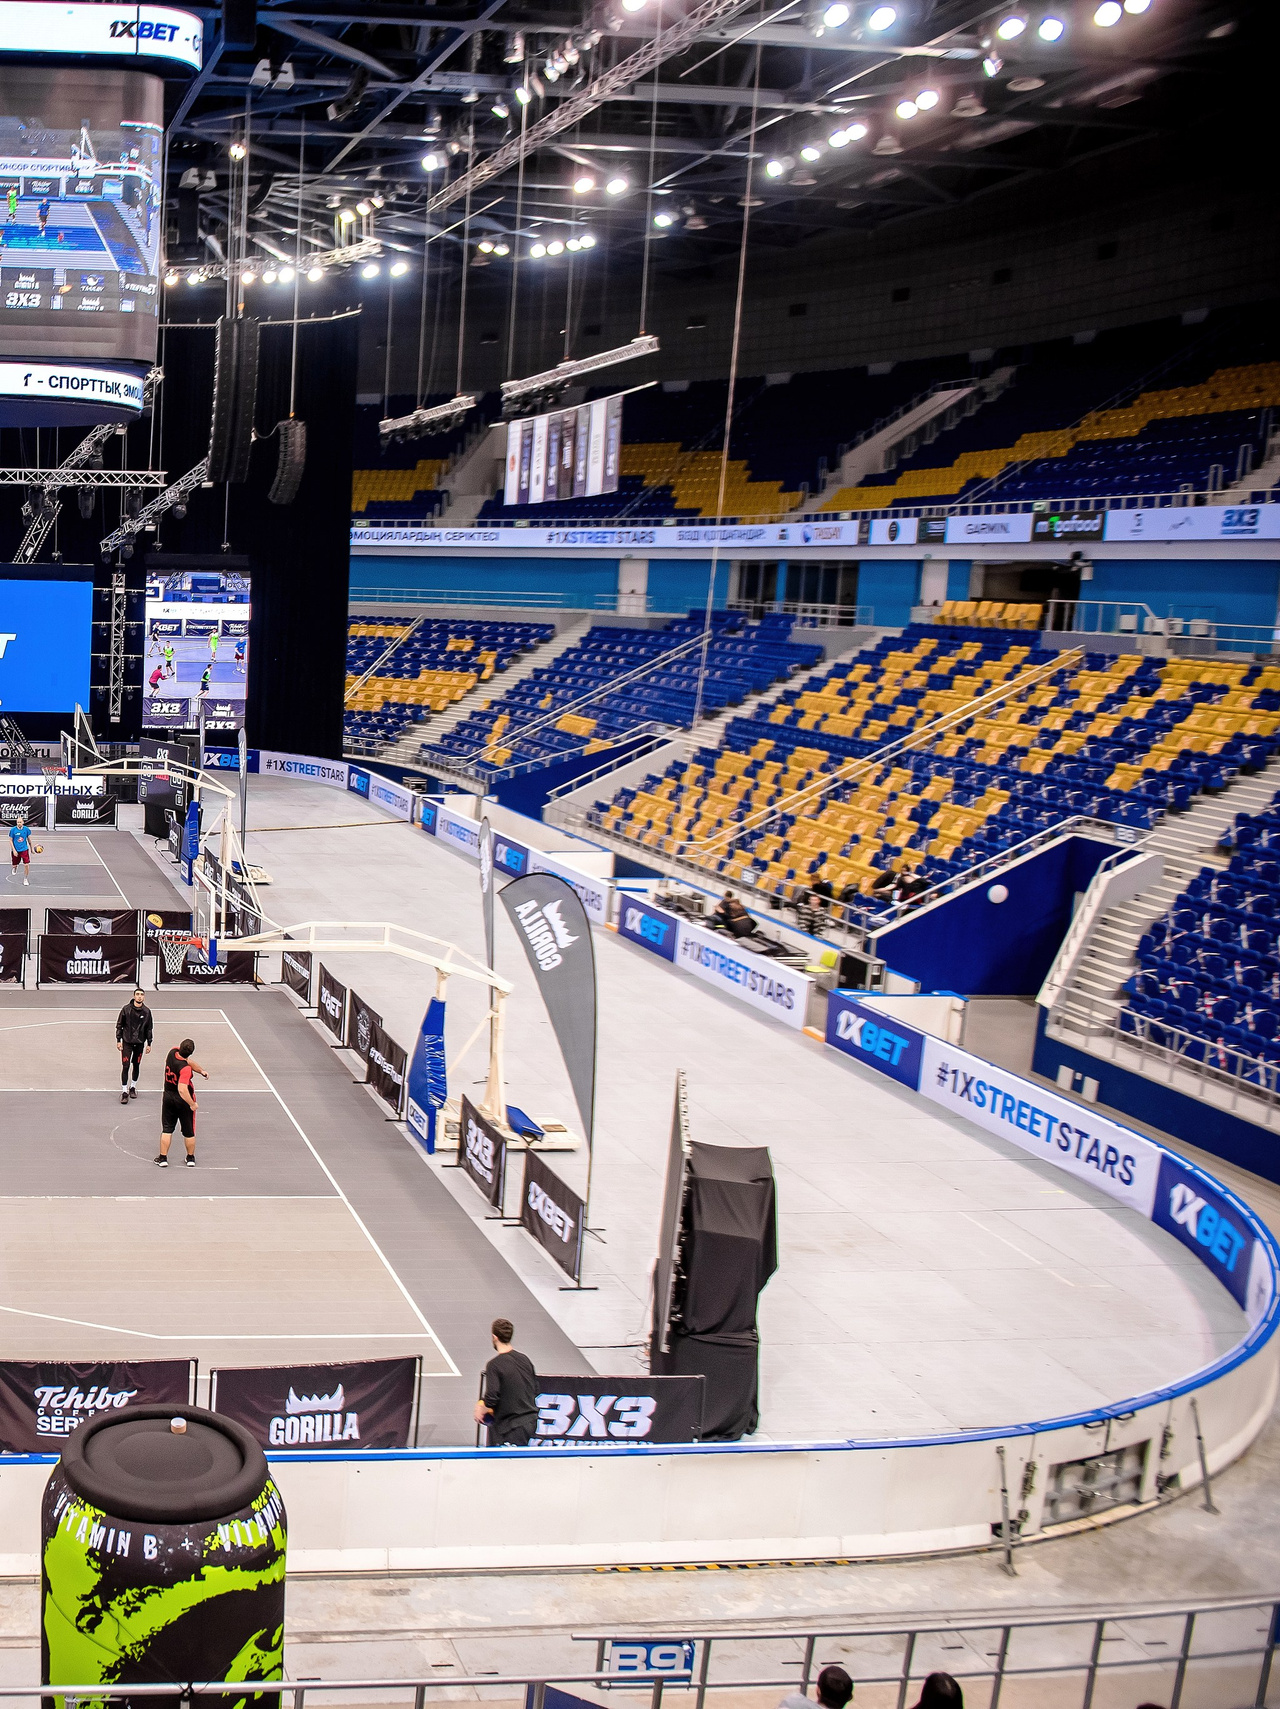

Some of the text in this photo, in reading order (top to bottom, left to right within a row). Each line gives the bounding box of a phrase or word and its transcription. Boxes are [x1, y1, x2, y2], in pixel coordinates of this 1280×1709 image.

[110, 20, 180, 42] 1XBET
[48, 375, 122, 398] СПОРТТЫҚ
[546, 530, 656, 544] #1XSTREETSTARS
[266, 759, 344, 782] #1XSTREETSTARS
[350, 772, 368, 791] 1XBET
[2, 784, 92, 796] СПОРТИВНЫХ
[372, 784, 408, 813] #1XSTREETSTARS
[0, 804, 32, 812] Tchibo
[72, 810, 100, 819] GORILLA
[496, 843, 525, 872] 1XBET
[624, 908, 670, 946] 1XBET
[66, 960, 110, 974] GORILLA
[187, 965, 227, 975] TASSAY
[680, 937, 796, 1010] #1XSTREETSTARS
[835, 1010, 910, 1066] 1XBET
[936, 1061, 1136, 1186] #1XSTREETSTARS
[466, 1118, 494, 1170] 3X3
[528, 1180, 575, 1244] 1XBET
[1170, 1183, 1246, 1272] 1XBET
[34, 1385, 138, 1410] Tchibo
[268, 1412, 360, 1446] GORILLA
[534, 1393, 658, 1438] 3X3
[52, 1492, 132, 1558] VITAMIN
[143, 1534, 158, 1560] B
[609, 1644, 686, 1672] B9
